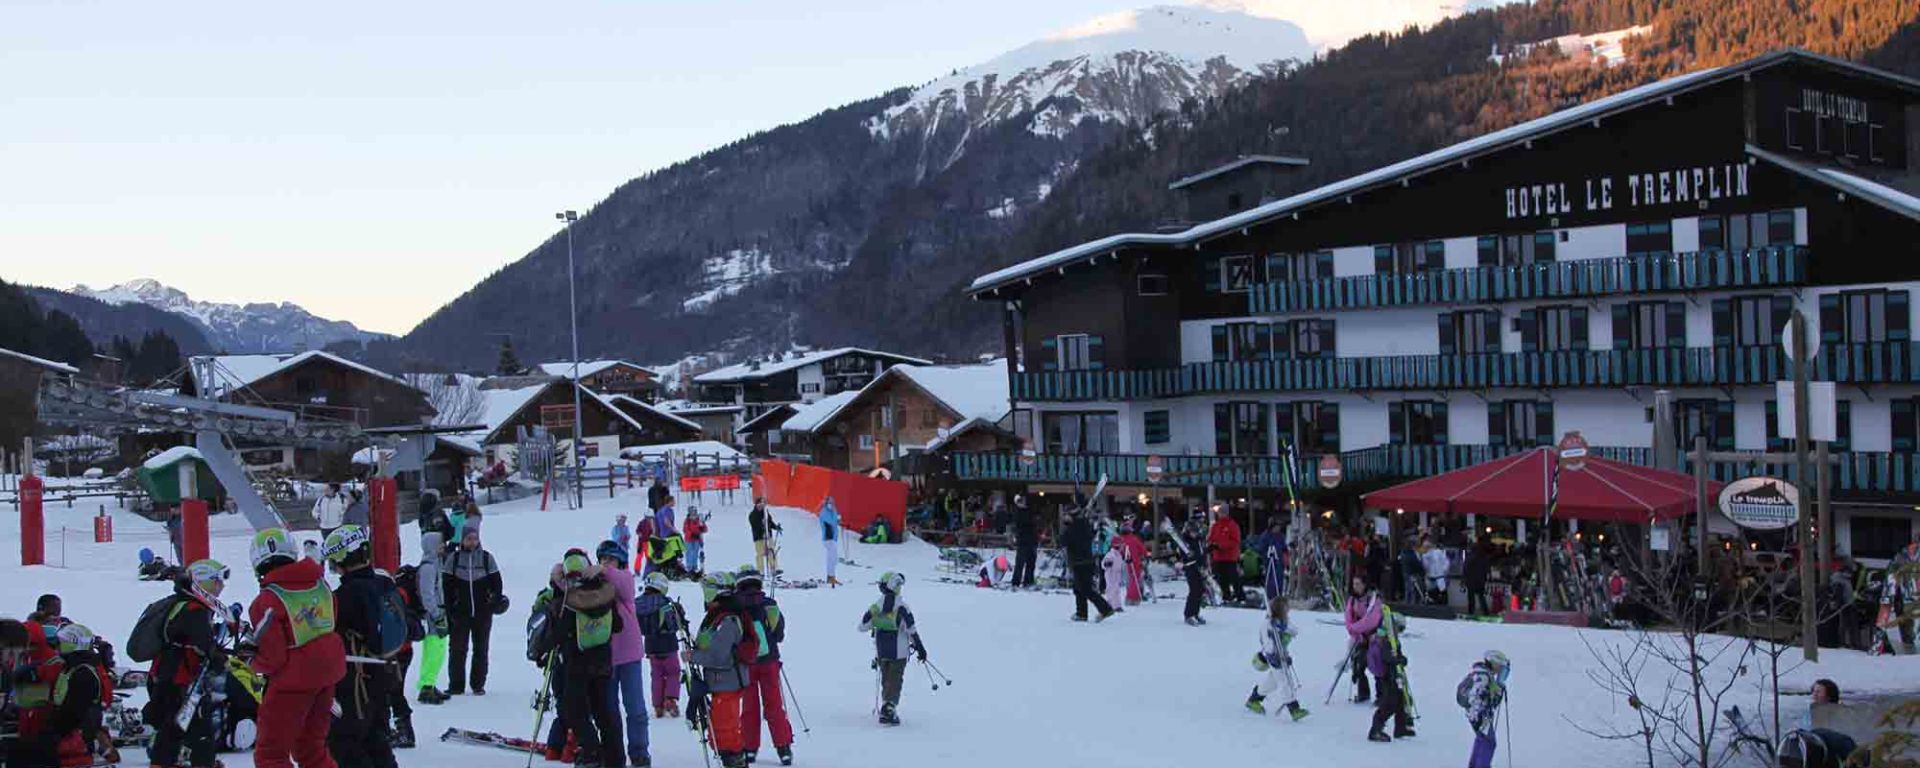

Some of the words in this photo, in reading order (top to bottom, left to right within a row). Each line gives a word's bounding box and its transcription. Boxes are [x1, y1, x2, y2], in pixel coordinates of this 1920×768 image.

[1506, 183, 1571, 218] HOTEL
[1586, 178, 1612, 210] LE
[1628, 163, 1748, 206] TREMPLIN
